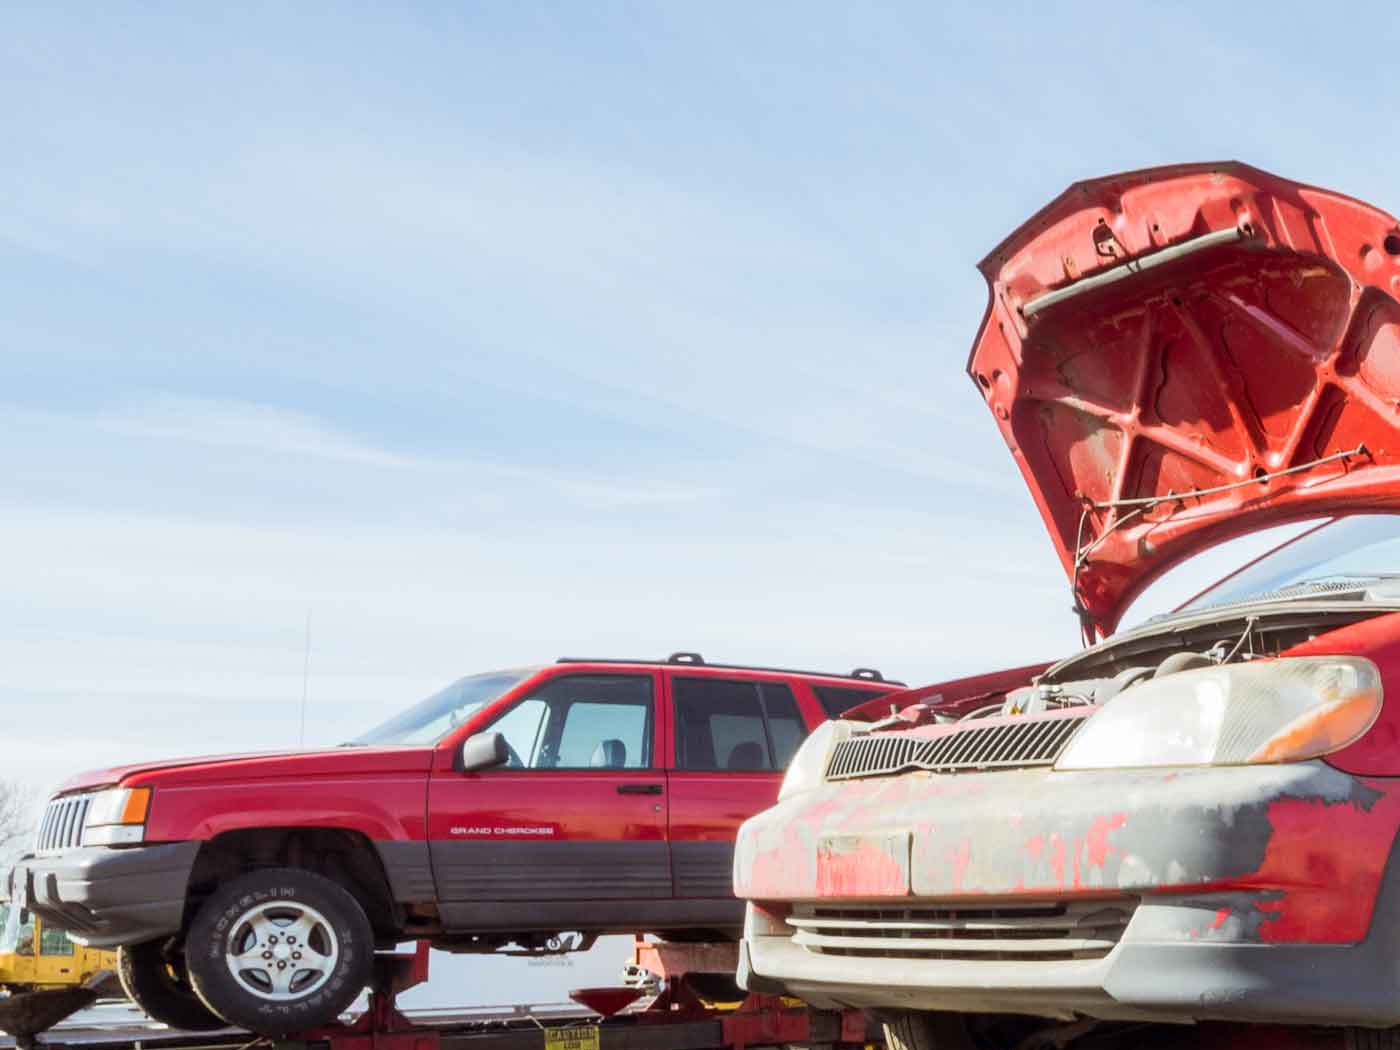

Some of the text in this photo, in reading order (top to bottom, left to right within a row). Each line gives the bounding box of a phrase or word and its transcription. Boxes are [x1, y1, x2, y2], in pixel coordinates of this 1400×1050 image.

[449, 827, 554, 835] GRAND CHEROKEE
[549, 1027, 594, 1041] CAUTION
